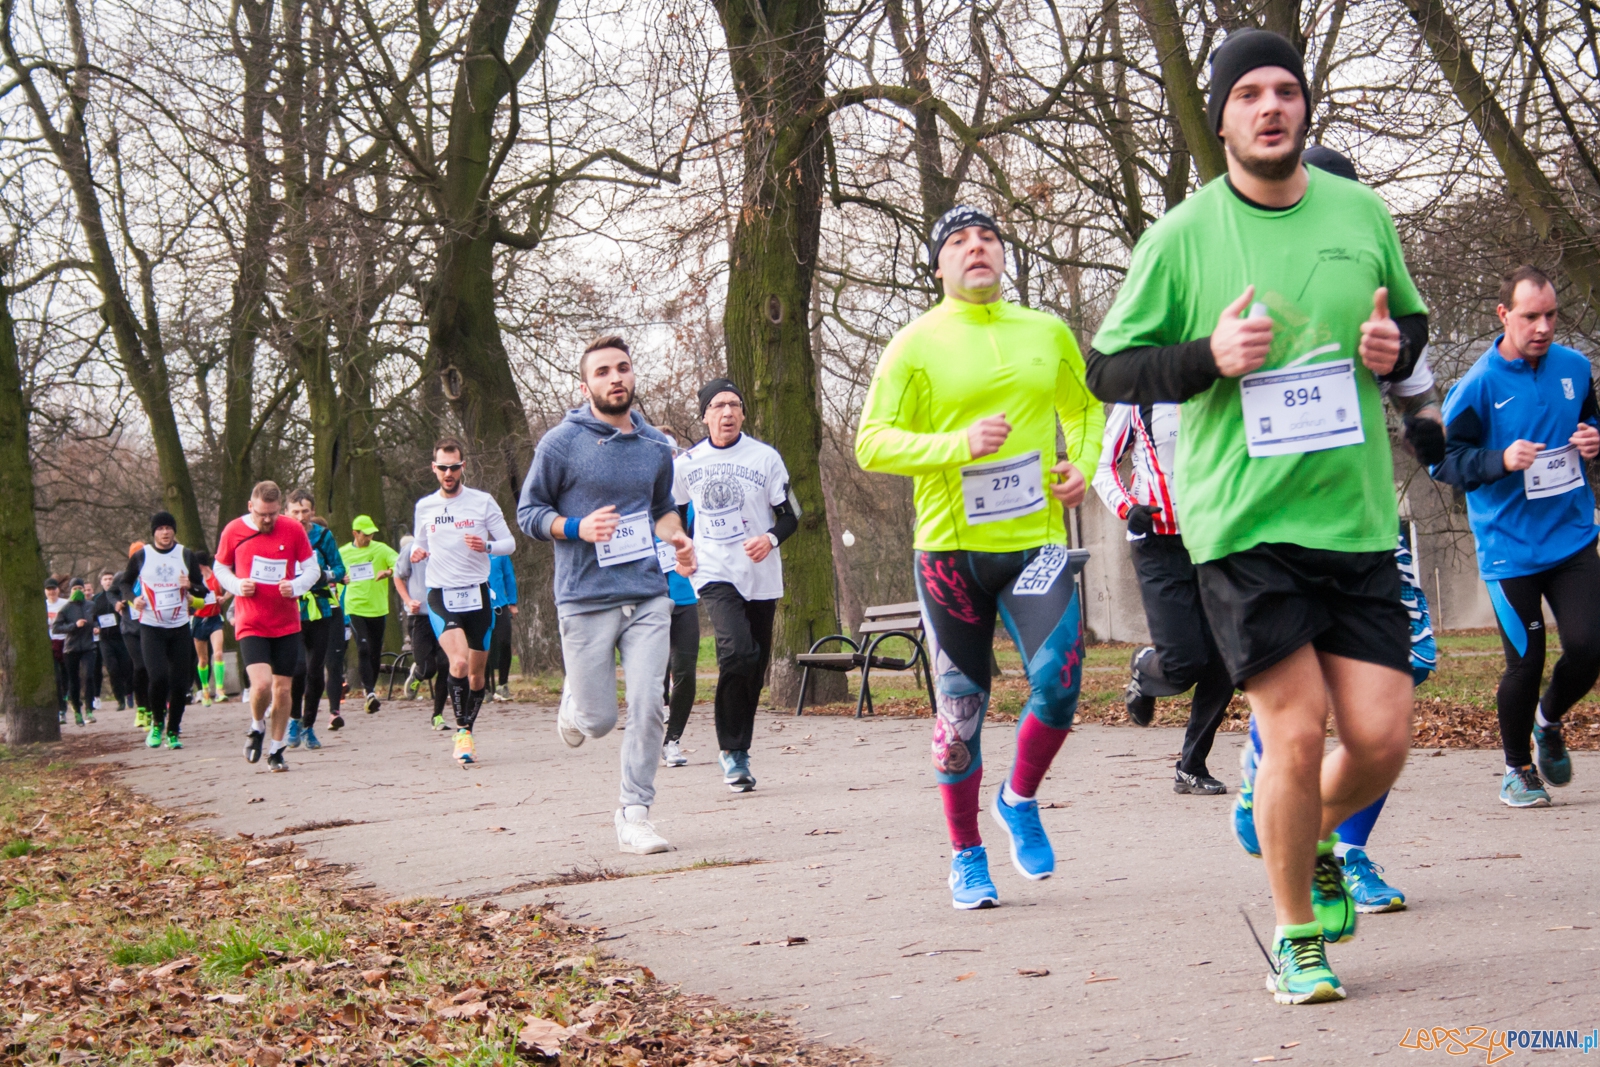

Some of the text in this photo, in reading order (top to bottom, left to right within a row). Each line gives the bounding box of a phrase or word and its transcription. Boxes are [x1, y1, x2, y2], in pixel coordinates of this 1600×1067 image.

[1284, 386, 1322, 408] 894
[1547, 457, 1566, 470] 406
[992, 474, 1020, 491] 279
[435, 515, 455, 524] RUN
[710, 518, 726, 527] 163
[616, 526, 635, 539] 286
[657, 550, 667, 558] 73
